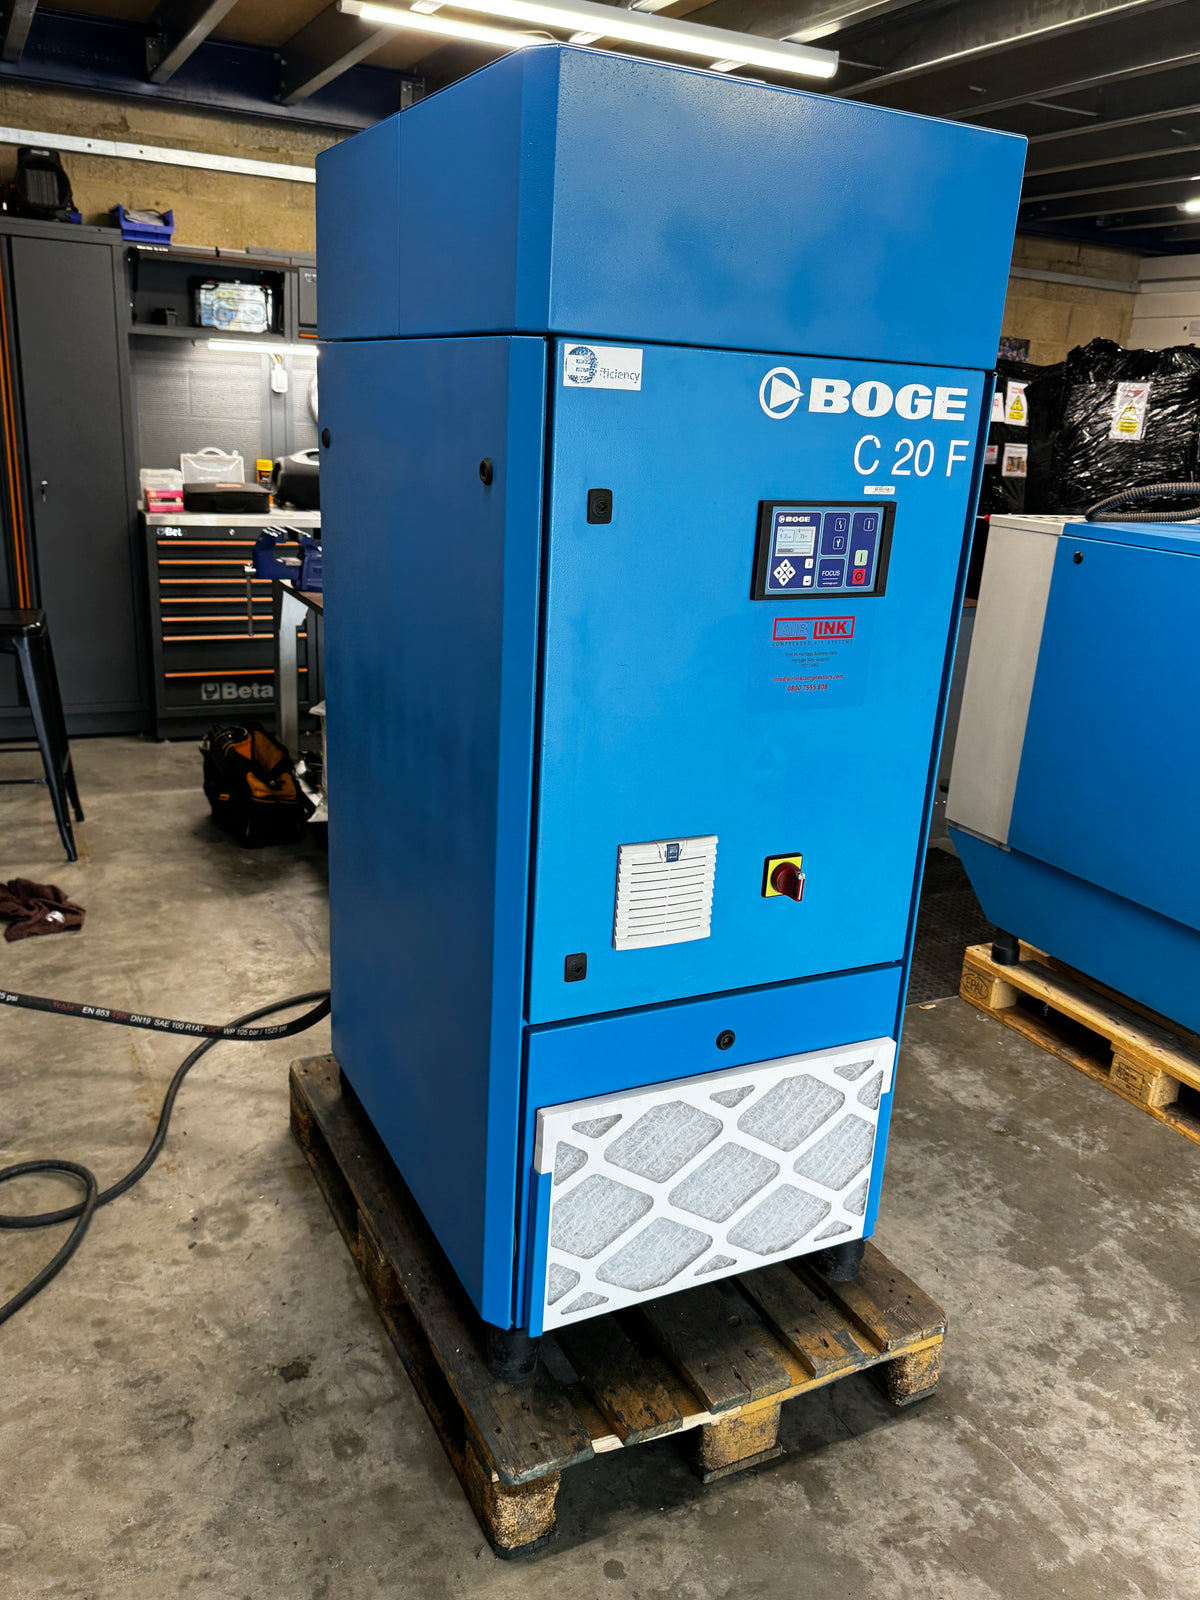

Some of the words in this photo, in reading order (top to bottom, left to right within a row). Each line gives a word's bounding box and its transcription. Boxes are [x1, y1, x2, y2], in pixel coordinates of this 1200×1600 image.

[808, 377, 969, 421] BOGE
[853, 434, 882, 476] C
[891, 437, 935, 477] 20
[945, 439, 970, 477] F
[165, 526, 188, 537] Bet
[222, 682, 274, 700] Beta
[82, 1006, 95, 1015] EN
[95, 1009, 110, 1018] 853
[130, 1014, 152, 1025] DN19
[154, 1019, 171, 1028] SAE
[171, 1021, 185, 1030] 100
[185, 1023, 205, 1033] R1AT
[223, 1027, 236, 1035] WP
